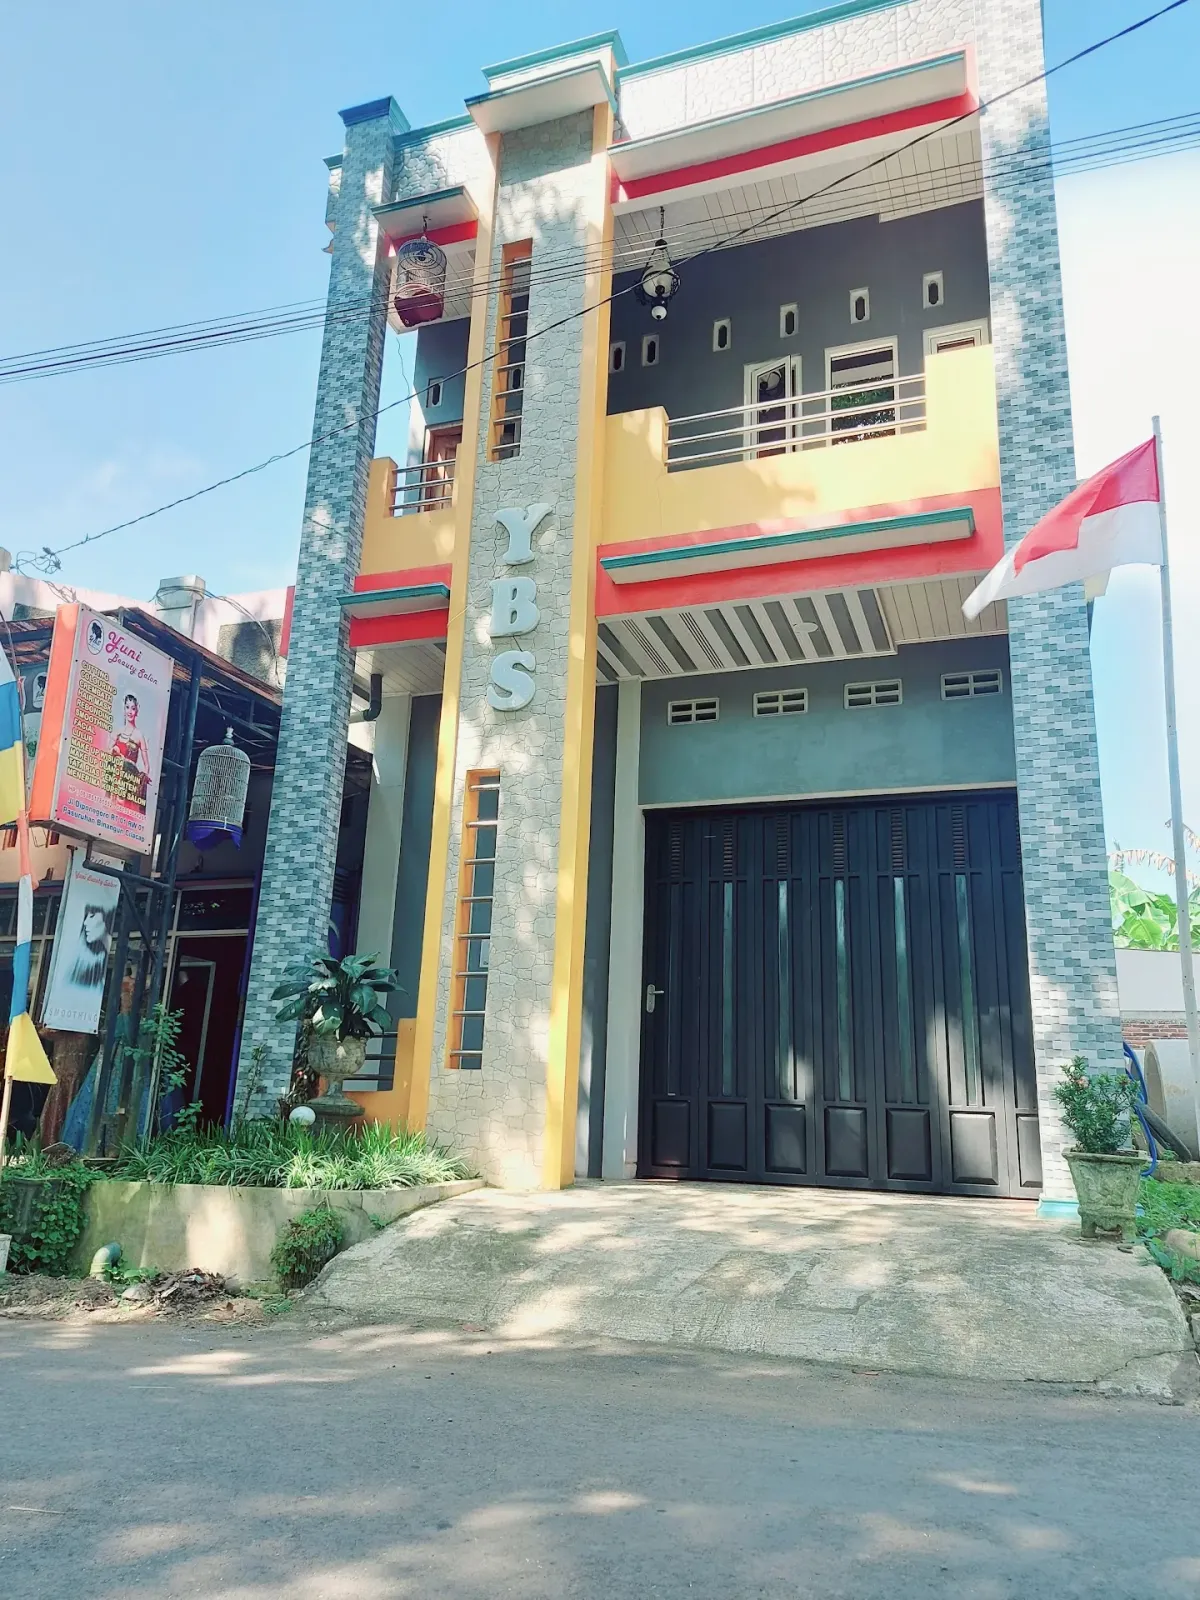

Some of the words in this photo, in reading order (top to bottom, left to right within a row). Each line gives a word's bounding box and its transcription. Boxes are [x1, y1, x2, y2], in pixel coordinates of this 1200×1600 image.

[105, 631, 142, 662] Yuni
[80, 669, 117, 695] COLOURING
[81, 660, 109, 681] CUTTING
[108, 653, 137, 675] Beauty
[138, 668, 158, 685] Salon
[78, 688, 93, 702] HAIR
[94, 696, 112, 712] MASK
[79, 679, 113, 702] CREMBATH
[75, 708, 112, 733] SMOOTHING
[76, 698, 113, 723] REBONDING
[72, 727, 93, 743] LULUR
[73, 717, 96, 735] FACIAL
[71, 737, 90, 751] MAKE
[90, 746, 99, 755] UP
[100, 750, 124, 766] WISUDA
[68, 756, 84, 769] TATA
[85, 764, 99, 777] RIAS
[100, 770, 137, 792] PENGANTEN
[69, 747, 88, 760] MAKE
[88, 755, 98, 765] UP
[100, 760, 120, 775] ULANG
[120, 770, 141, 784] TAHUN
[67, 767, 100, 788] MENERIMA
[101, 781, 126, 797] KURSUS
[126, 792, 146, 806] SALON
[62, 806, 96, 824] Pasuruhan
[97, 818, 124, 834] Binangun
[125, 829, 145, 842] Cilacap
[75, 800, 109, 819] Diponegoro
[111, 813, 118, 821] RT
[127, 820, 137, 829] RW
[49, 1007, 98, 1022] SMOOTHING
